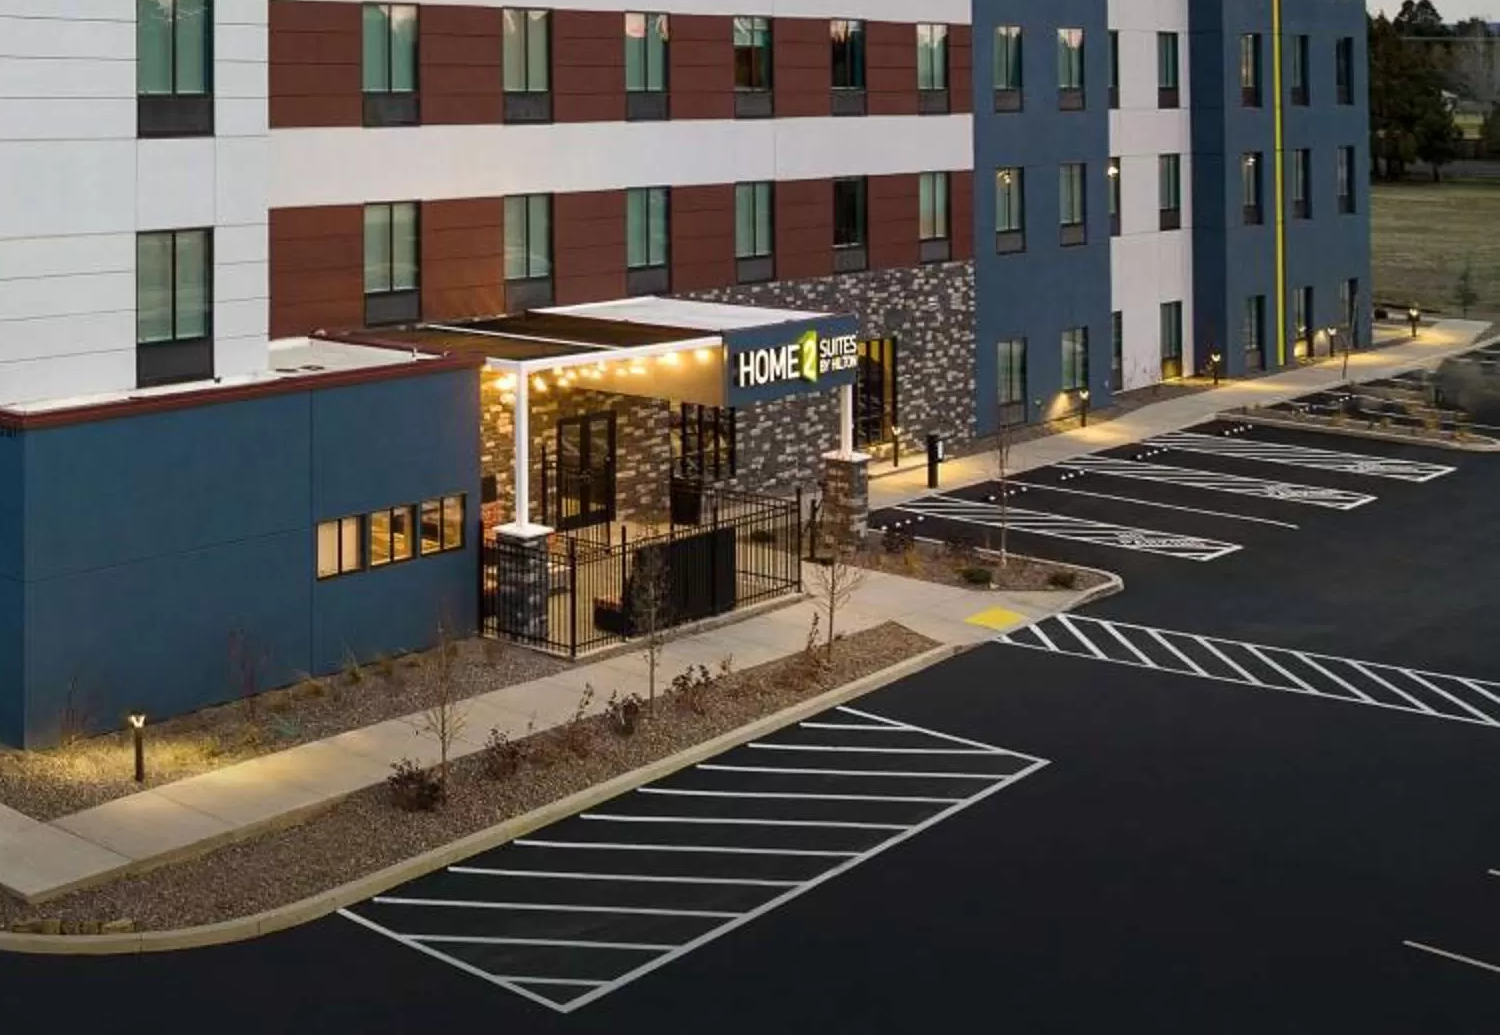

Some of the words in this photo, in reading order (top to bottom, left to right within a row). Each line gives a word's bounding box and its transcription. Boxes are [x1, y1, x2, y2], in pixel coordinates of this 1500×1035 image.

[819, 335, 857, 358] SUITES
[819, 359, 831, 374] BY
[831, 355, 858, 371] HILTON
